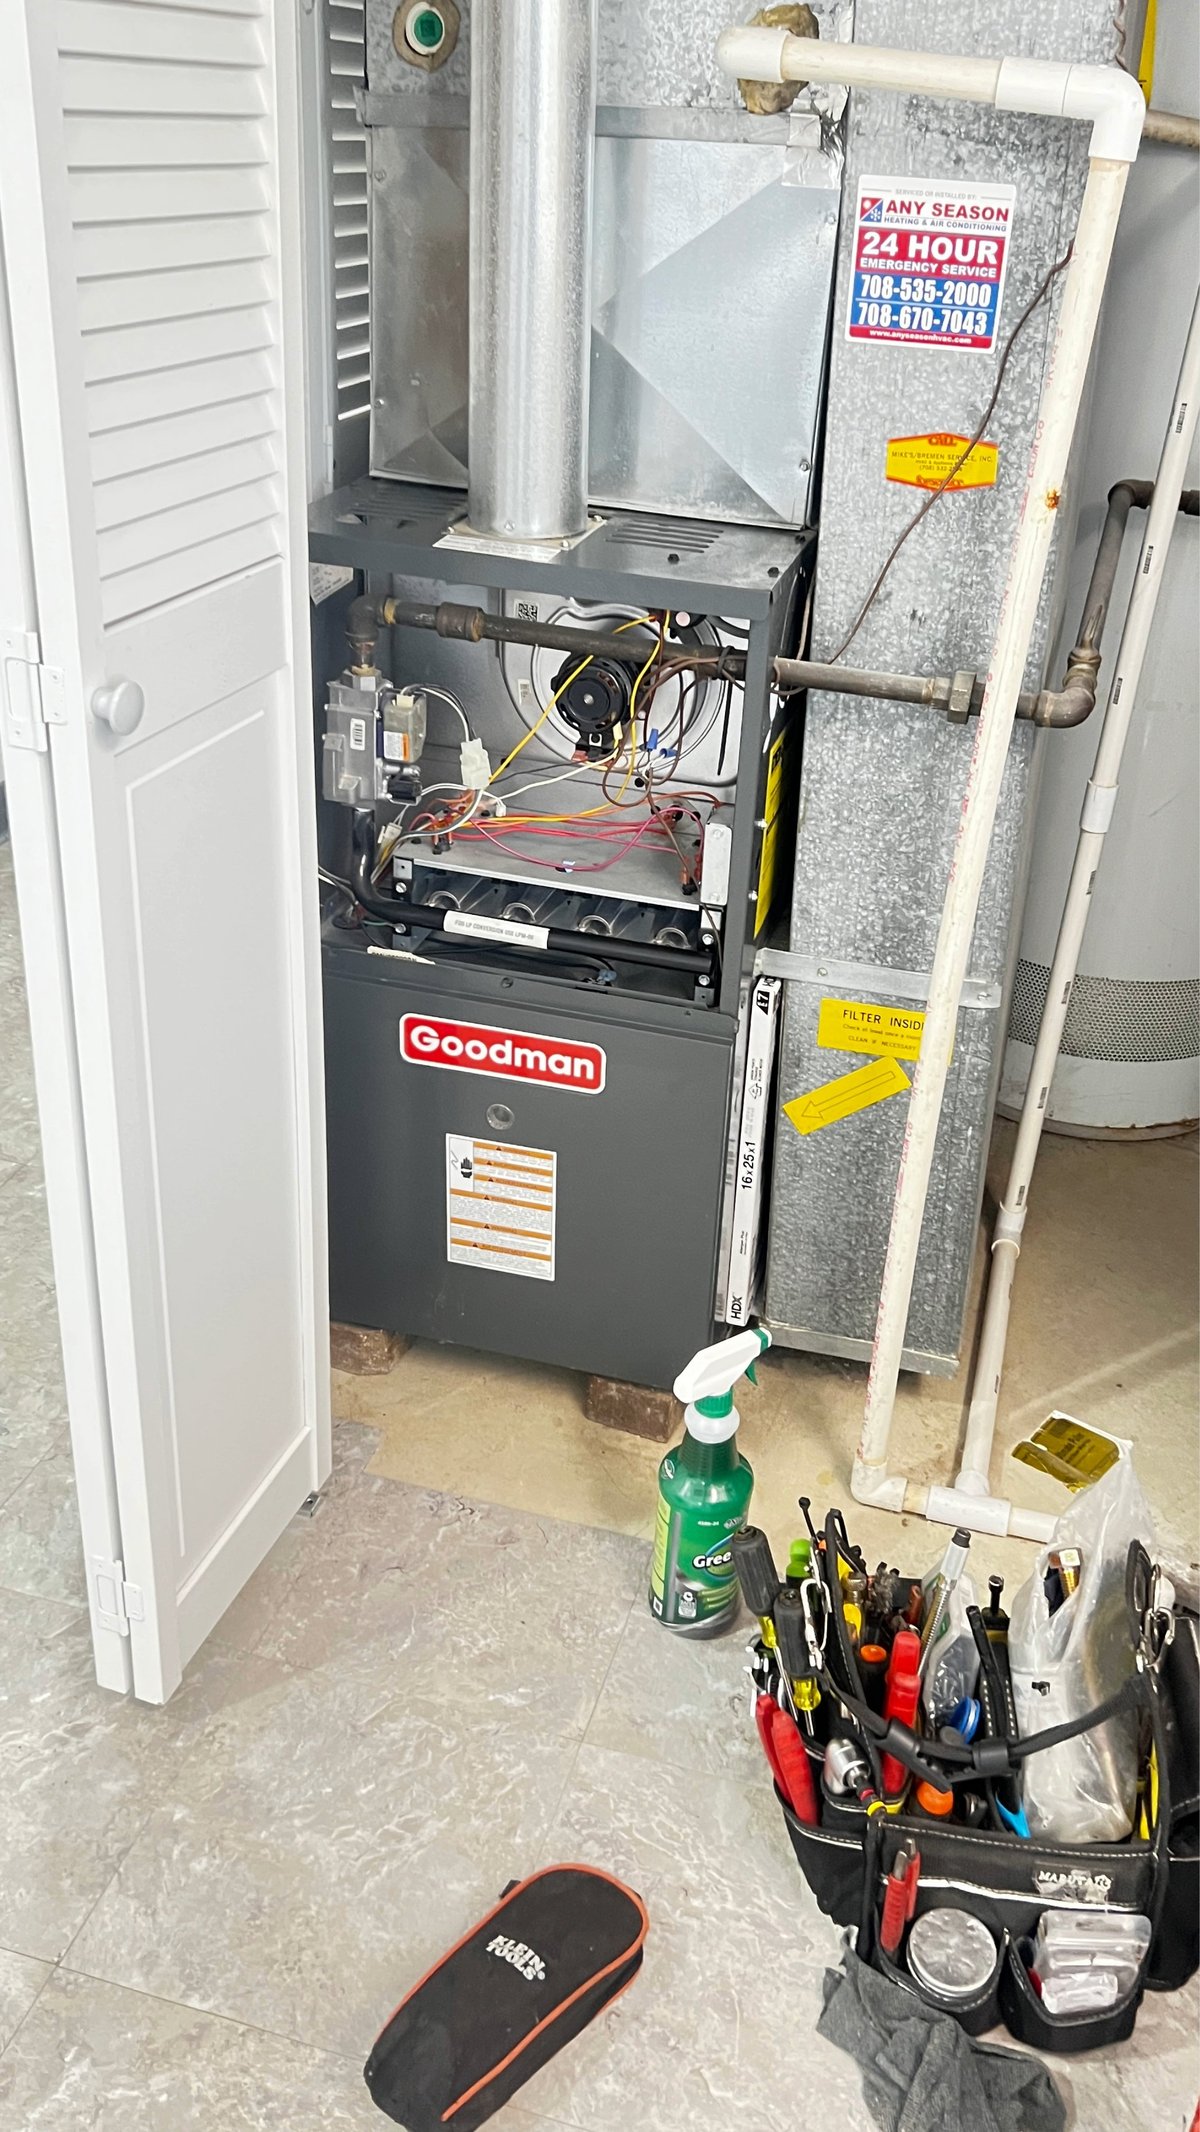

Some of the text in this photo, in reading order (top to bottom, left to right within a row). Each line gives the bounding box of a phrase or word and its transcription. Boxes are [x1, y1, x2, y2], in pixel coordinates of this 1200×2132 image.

[885, 199, 1009, 222] ANY SEASON
[884, 216, 919, 225] HEATING
[930, 219, 944, 227] AIR
[946, 221, 1007, 232] CONDITIONING
[862, 231, 999, 264] 24 HOUR
[860, 257, 997, 278] EMERGENCY SERVICE
[861, 274, 992, 308] 708-535-2000
[858, 302, 988, 336] 708-670-7043
[869, 329, 972, 344] www.anyseasonhvac.com
[947, 454, 977, 462] SERCE,
[843, 1009, 882, 1025] FILTER
[410, 1025, 594, 1080] Goodman
[731, 1296, 743, 1319] HDX
[693, 1551, 732, 1569] Gree
[485, 1941, 537, 1981] TOOLS
[493, 1934, 546, 1972] KLEIN
